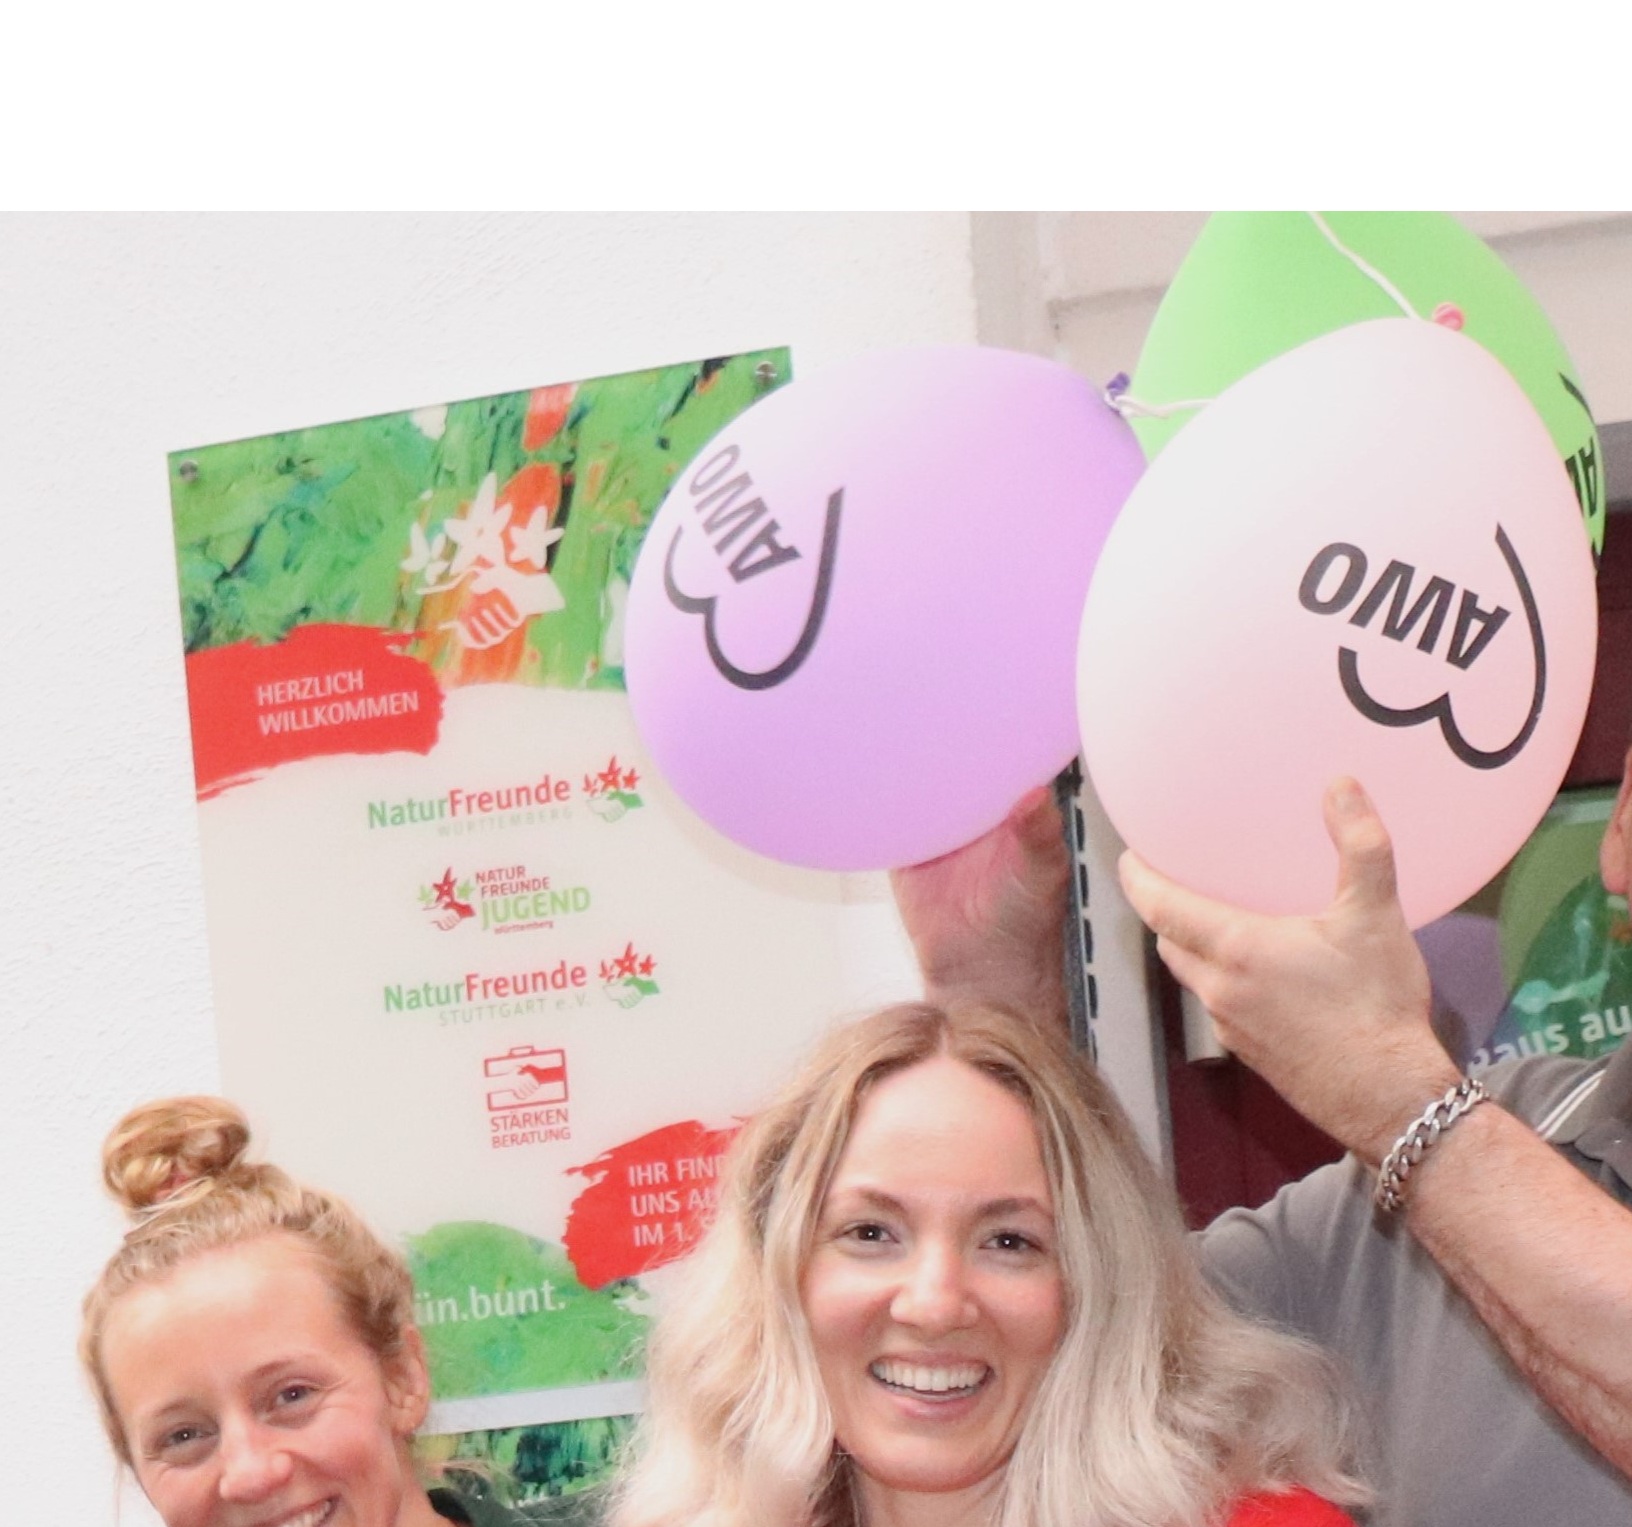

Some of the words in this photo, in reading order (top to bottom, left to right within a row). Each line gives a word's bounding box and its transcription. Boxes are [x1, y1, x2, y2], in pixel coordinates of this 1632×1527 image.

[689, 444, 802, 584] AWO
[1297, 541, 1512, 671] AWO
[257, 669, 364, 706] HERZLICH
[258, 691, 419, 735] WILLKOMMEN
[368, 775, 571, 829] NaturFreunde
[475, 865, 526, 884] NATUR
[480, 877, 551, 898] FREUNDE
[481, 886, 592, 931] JUGEND
[383, 960, 588, 1013] NaturFreunde
[439, 998, 545, 1027] STUTTGART
[490, 1108, 569, 1132] STÄRKEN
[491, 1127, 571, 1148] BERATUNG
[628, 1161, 669, 1187] IHR
[676, 1155, 725, 1181] FIN
[630, 1190, 681, 1217] UNS
[632, 1222, 665, 1247] IM
[413, 1280, 566, 1326] ün.bunt.
